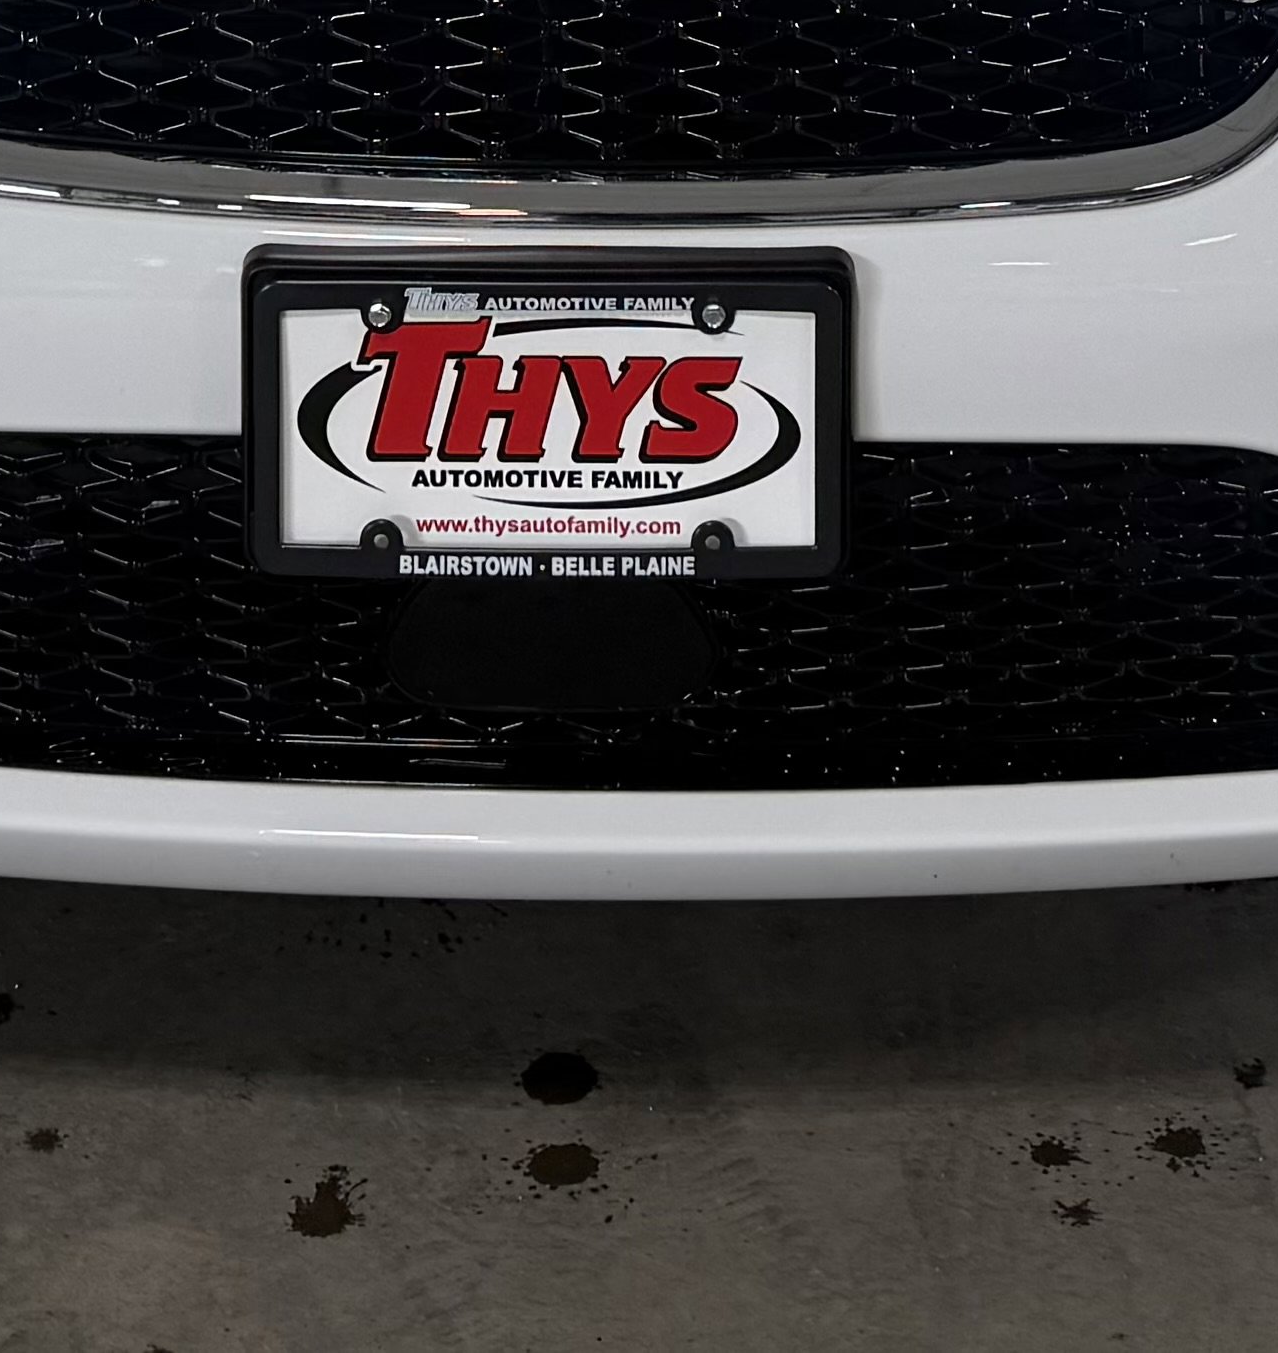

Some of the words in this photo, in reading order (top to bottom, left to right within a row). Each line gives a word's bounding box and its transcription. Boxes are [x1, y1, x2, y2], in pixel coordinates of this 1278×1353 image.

[404, 287, 480, 311] THYS
[484, 297, 617, 311] AUTOMOTIVE
[623, 297, 695, 311] FAMILY
[357, 317, 743, 463] THYS
[411, 469, 583, 489] AUTOMOTIVE
[591, 470, 684, 490] FAMILY
[416, 515, 681, 538] www.thysautofamily.com
[399, 555, 533, 577] BLAIRSTOWN
[551, 555, 616, 577] BELLE
[621, 555, 696, 577] PLAINE
